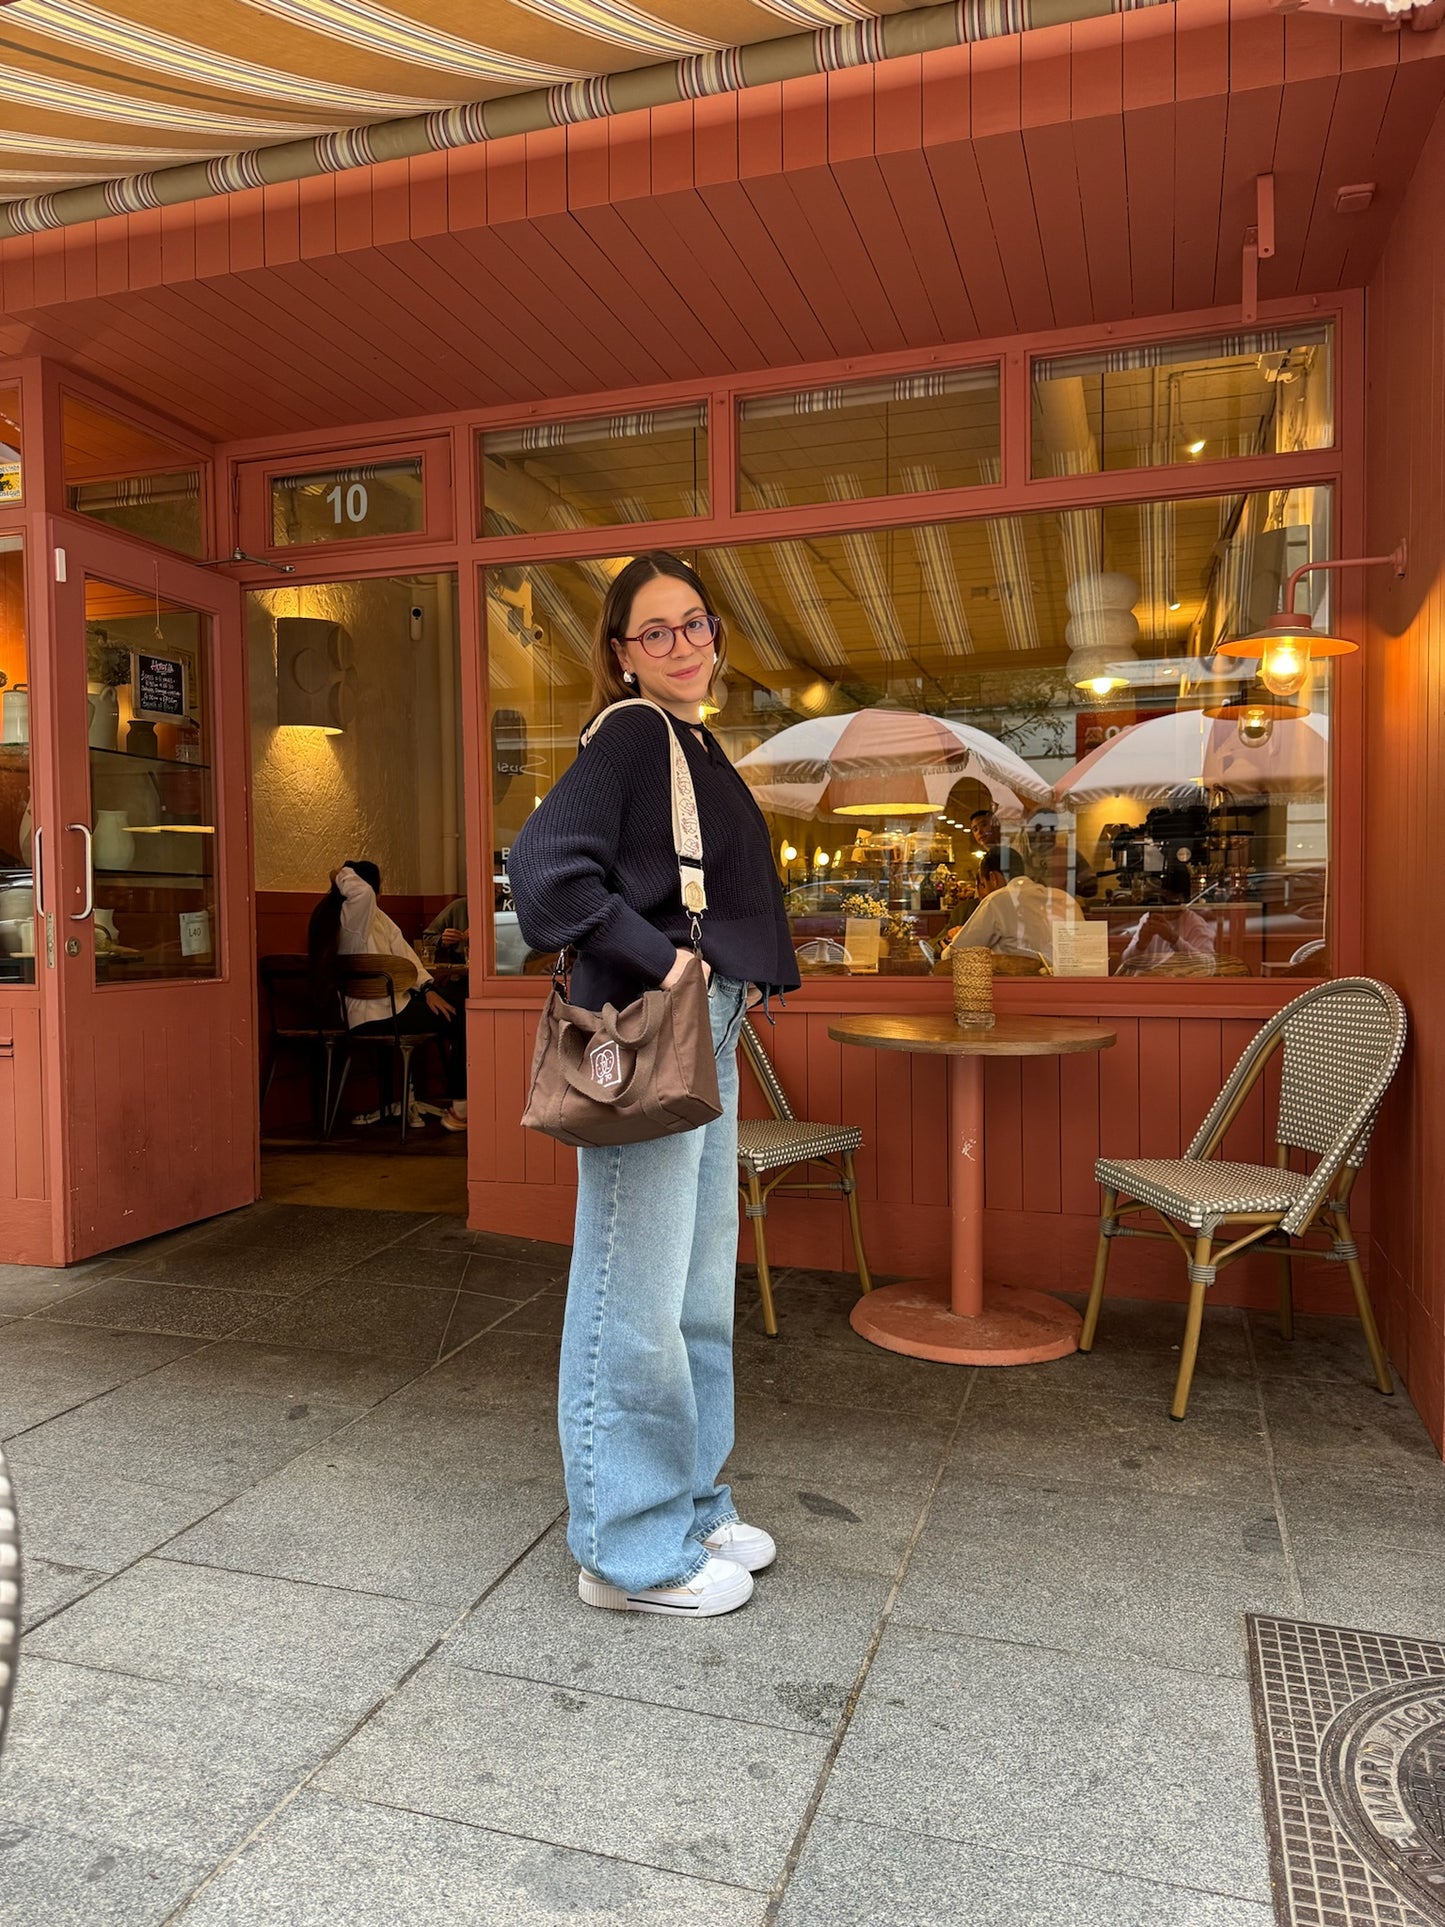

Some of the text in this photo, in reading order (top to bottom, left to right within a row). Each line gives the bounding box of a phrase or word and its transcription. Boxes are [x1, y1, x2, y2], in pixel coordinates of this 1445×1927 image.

[326, 483, 368, 524] 10
[1381, 1698, 1445, 1742] ALCA
[1360, 1741, 1406, 1824] MADRID
